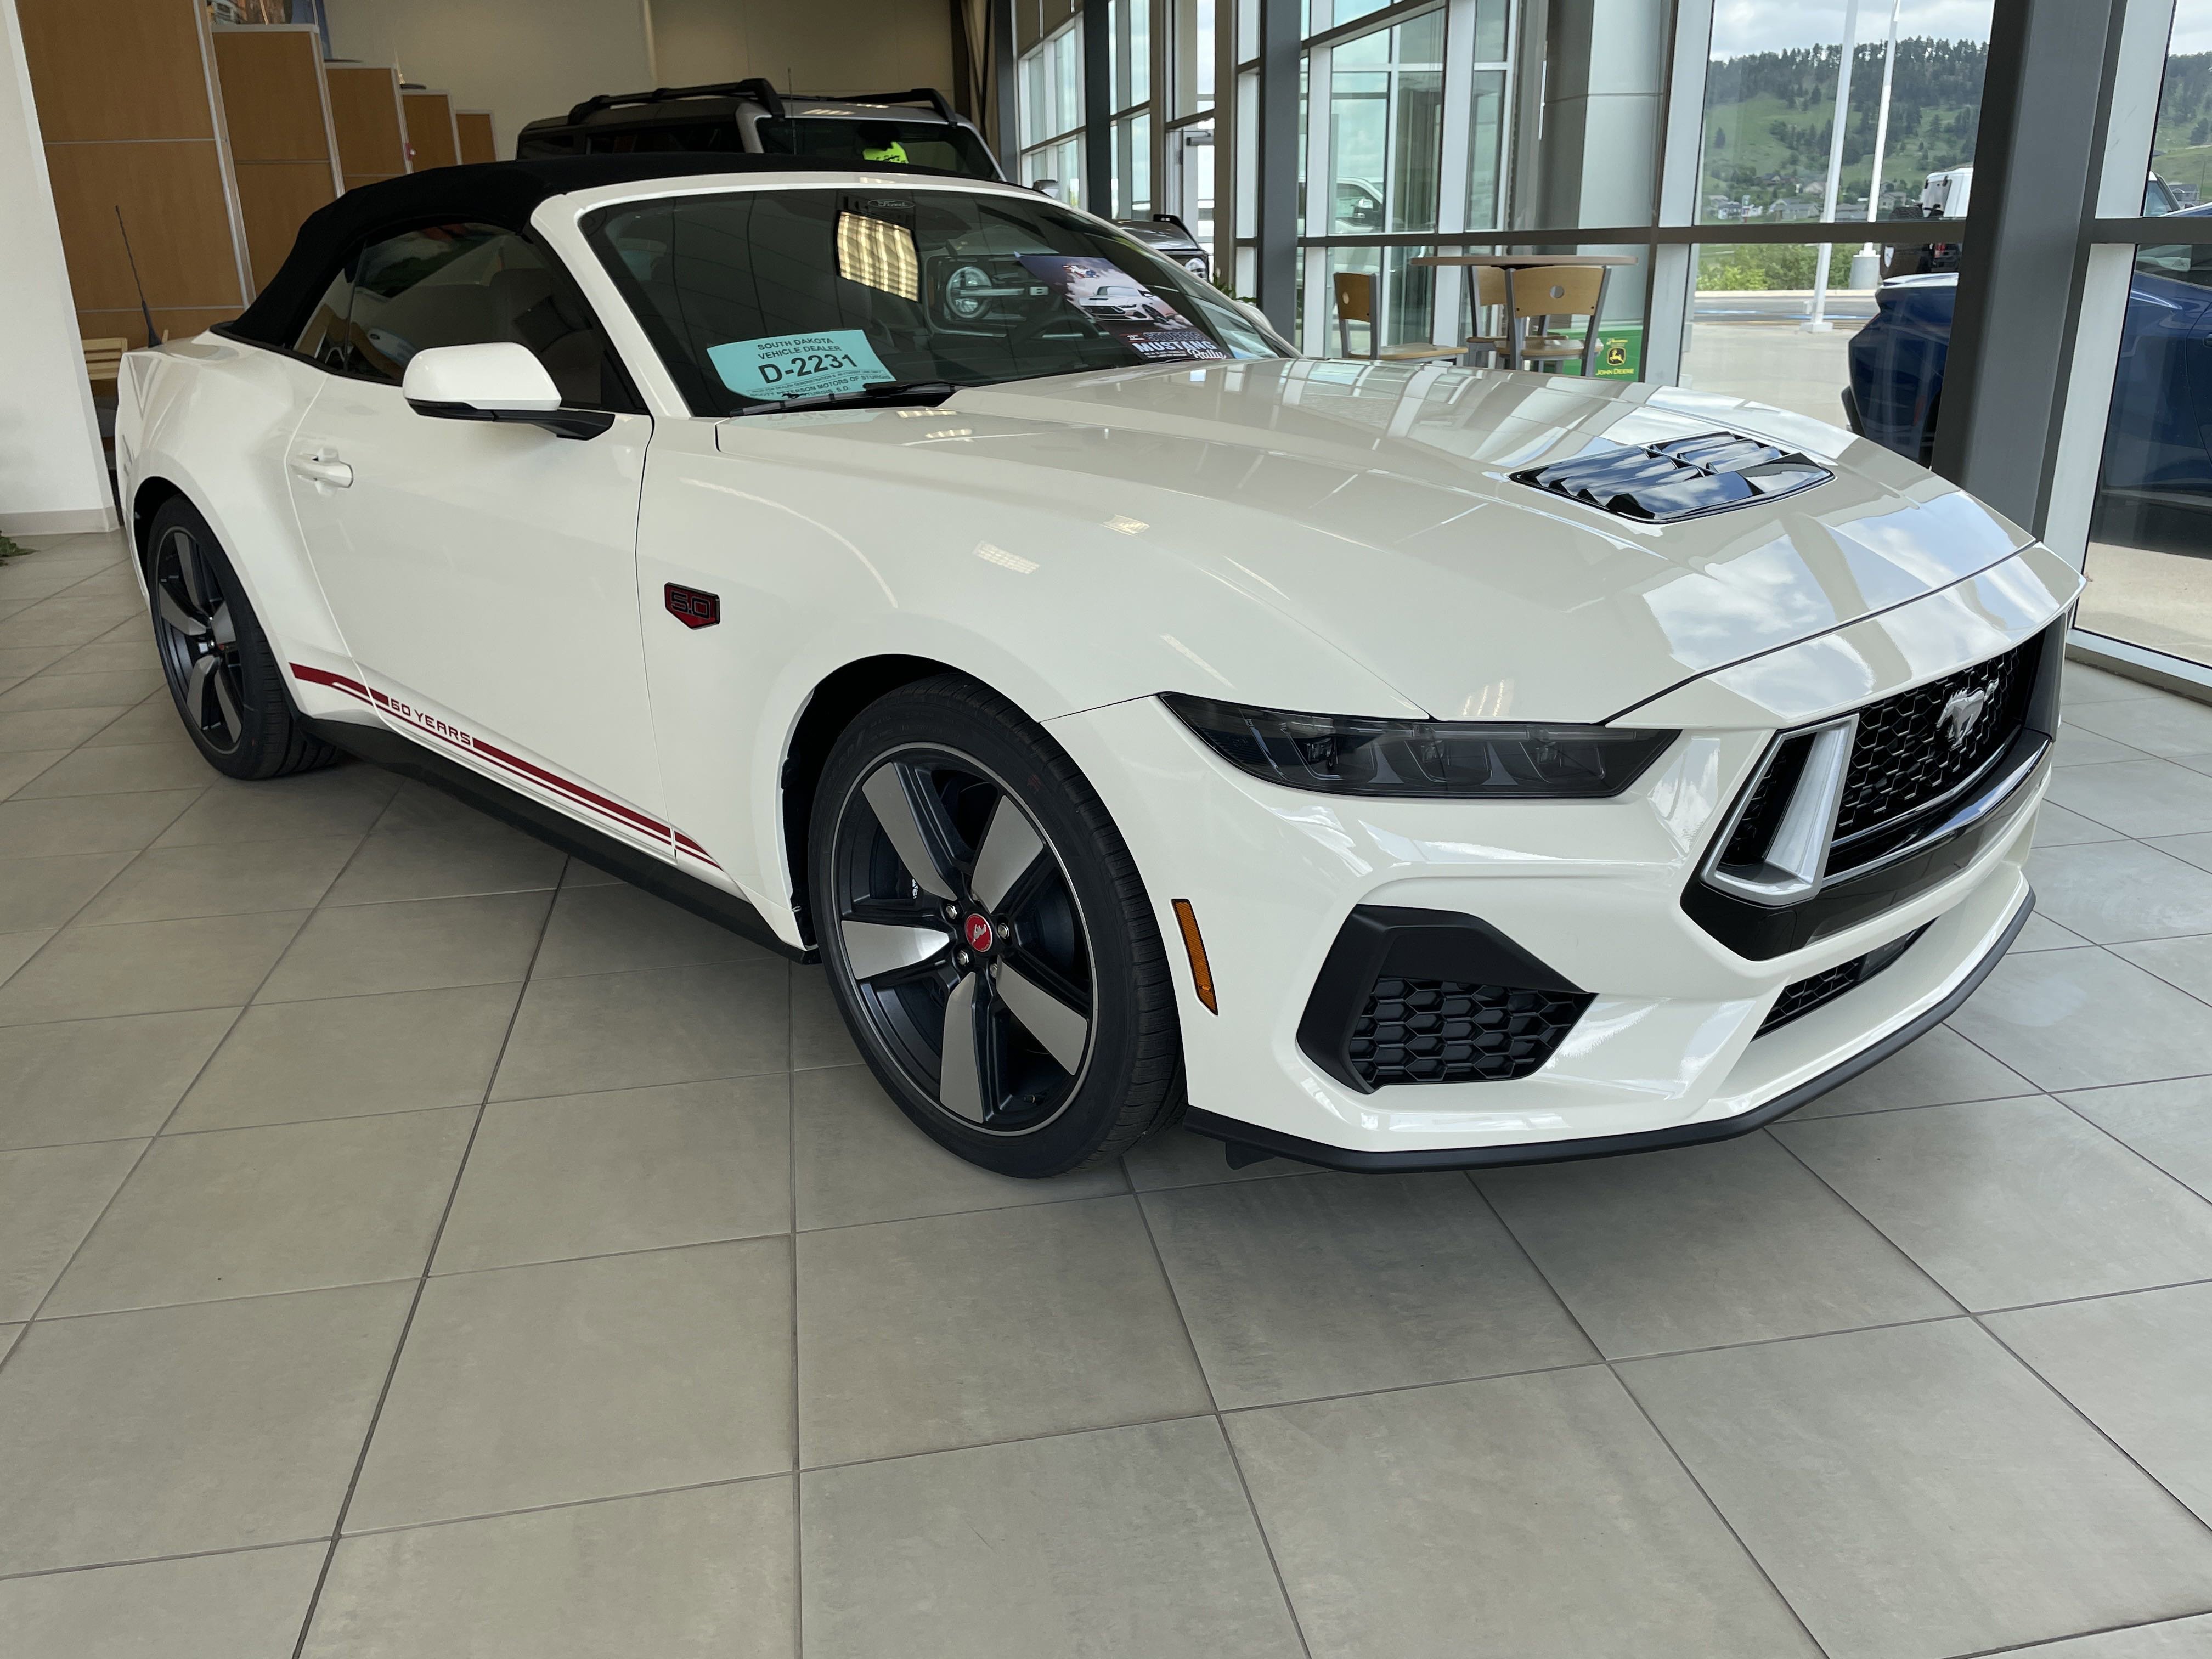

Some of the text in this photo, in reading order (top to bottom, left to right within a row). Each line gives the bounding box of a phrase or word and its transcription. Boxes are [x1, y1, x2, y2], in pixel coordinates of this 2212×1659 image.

[1143, 331, 1206, 342] STURGIS
[757, 340, 792, 351] SOUTH
[1132, 341, 1217, 352] MUSTANG
[758, 347, 802, 360] VEHICLE
[1187, 348, 1227, 360] Rally
[758, 353, 858, 384] D-2231
[777, 386, 816, 395] PETERSON
[817, 378, 849, 389] MOTORS
[670, 590, 710, 620] 5.0
[390, 698, 471, 746] 60 YEARS
